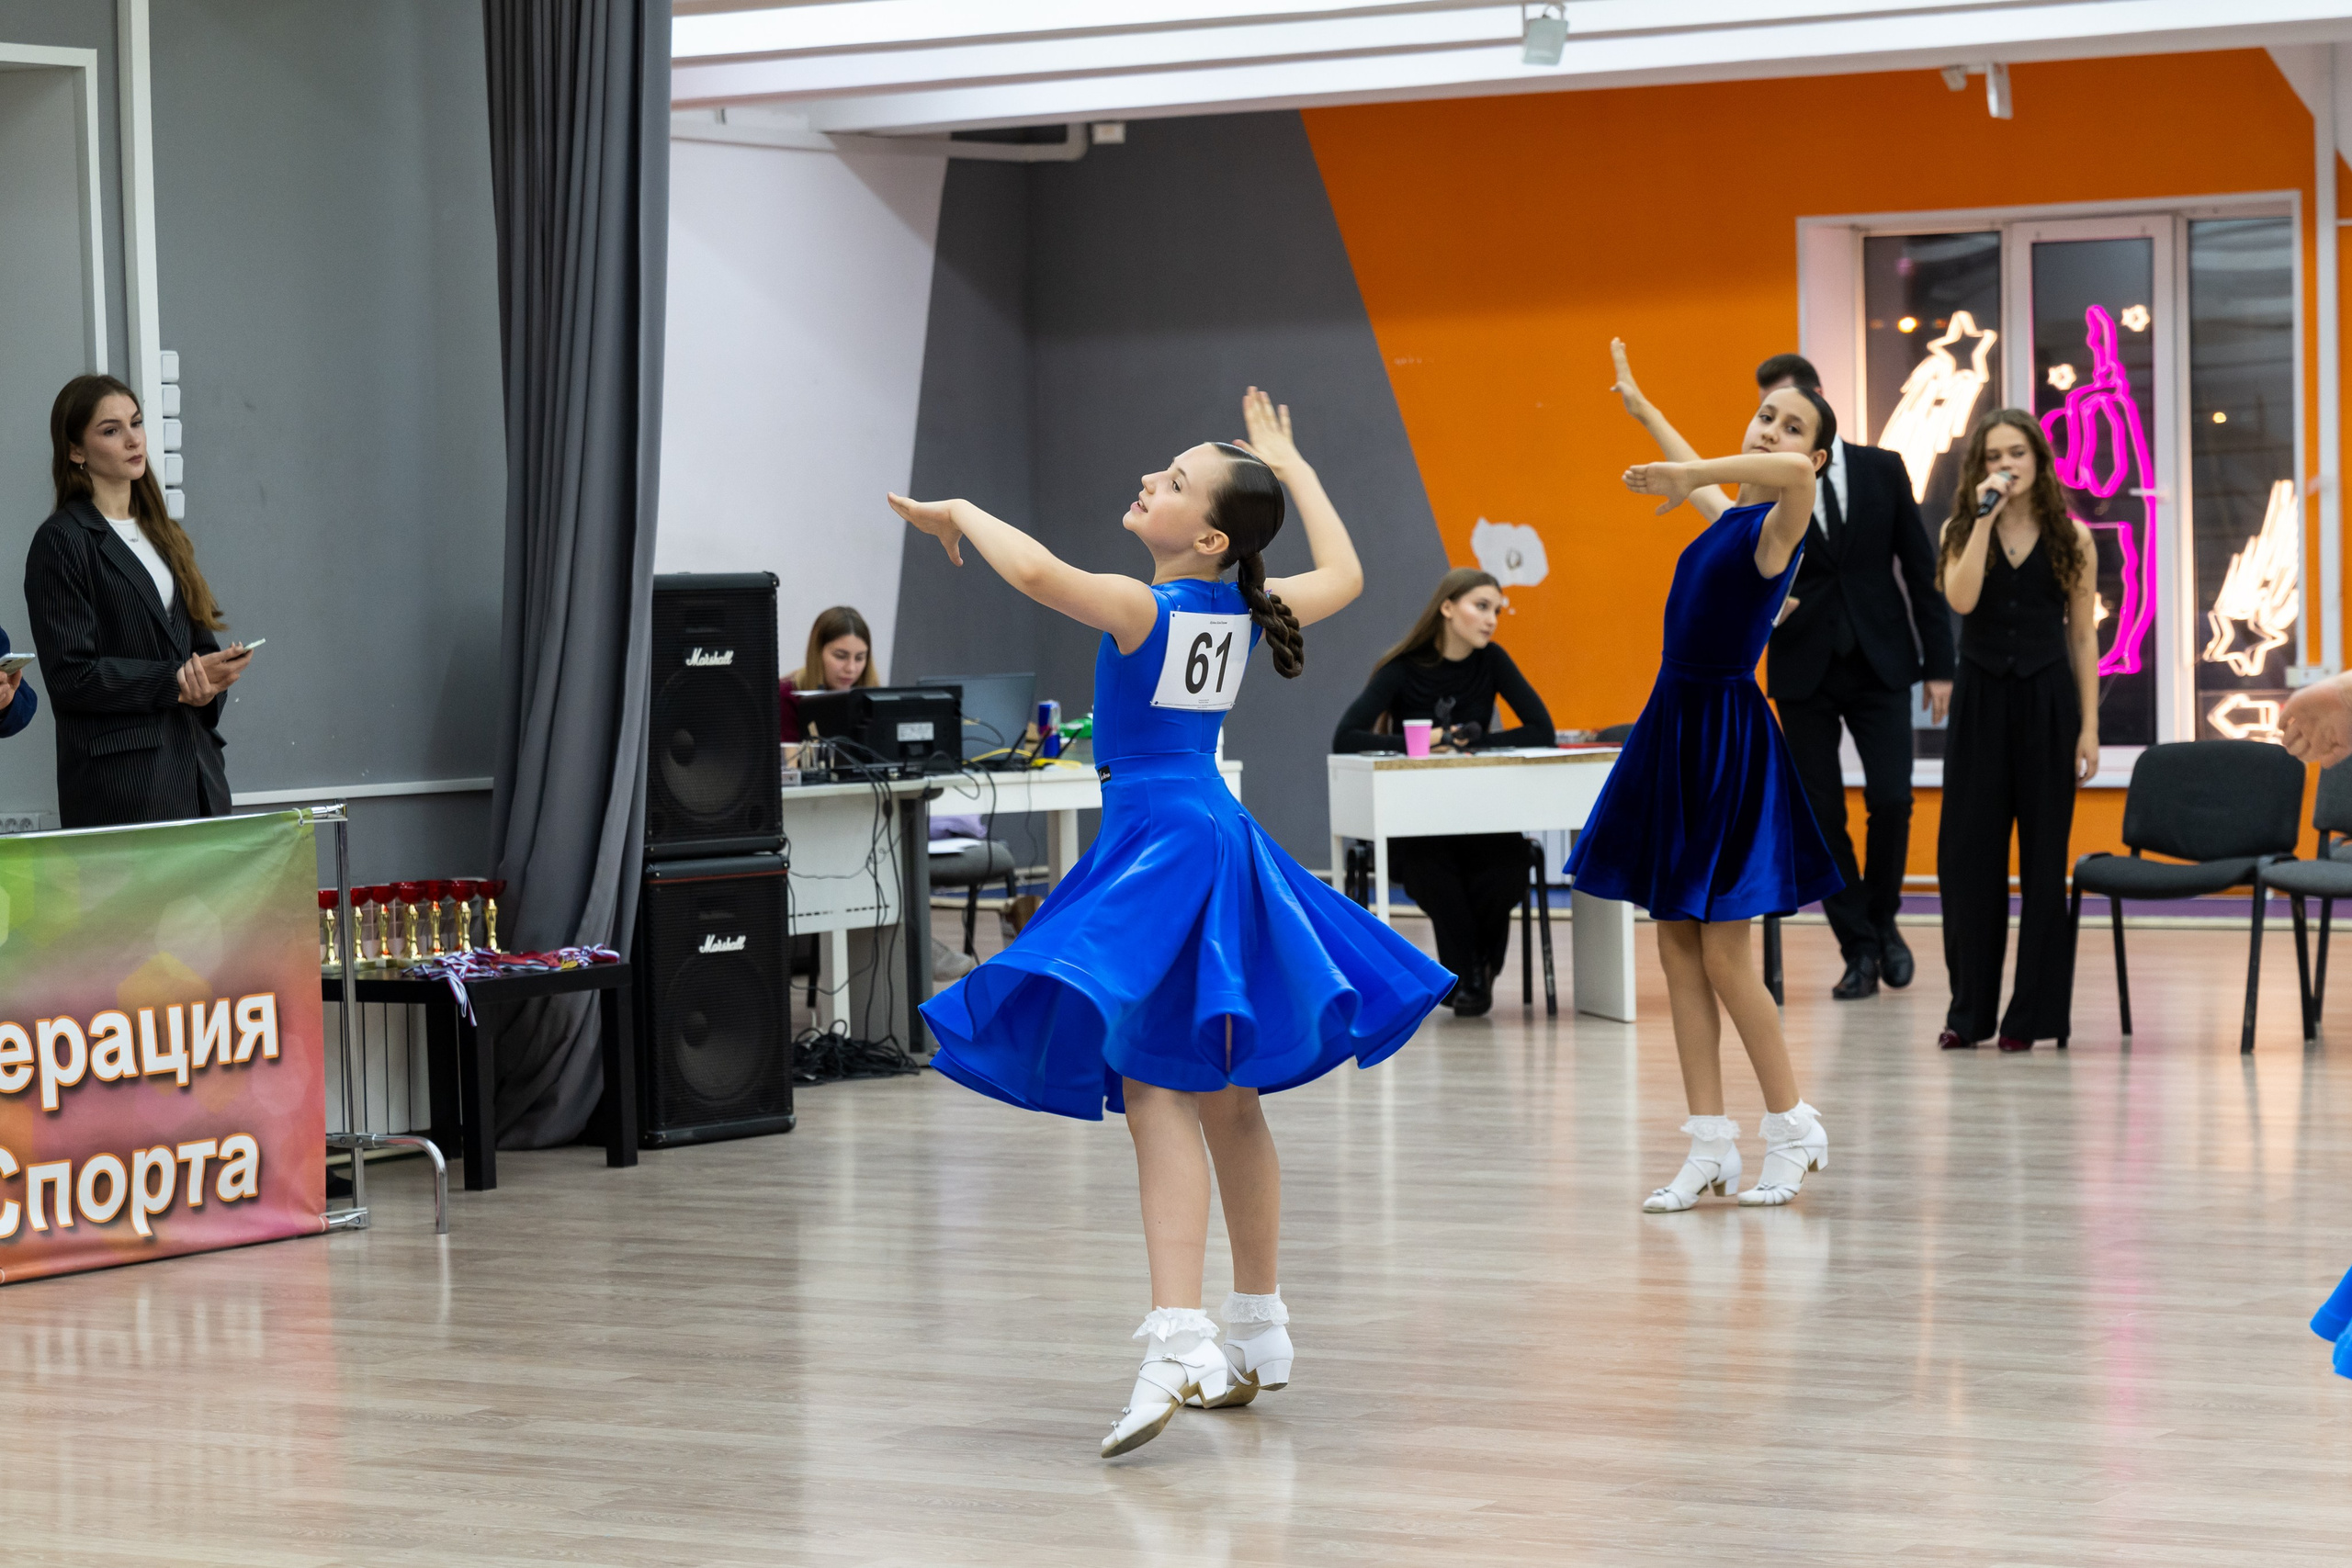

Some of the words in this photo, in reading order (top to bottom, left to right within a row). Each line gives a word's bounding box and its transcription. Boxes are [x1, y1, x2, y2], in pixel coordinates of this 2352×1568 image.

[685, 647, 734, 667] Marshall
[1185, 632, 1233, 694] 61
[699, 933, 747, 953] Marshall
